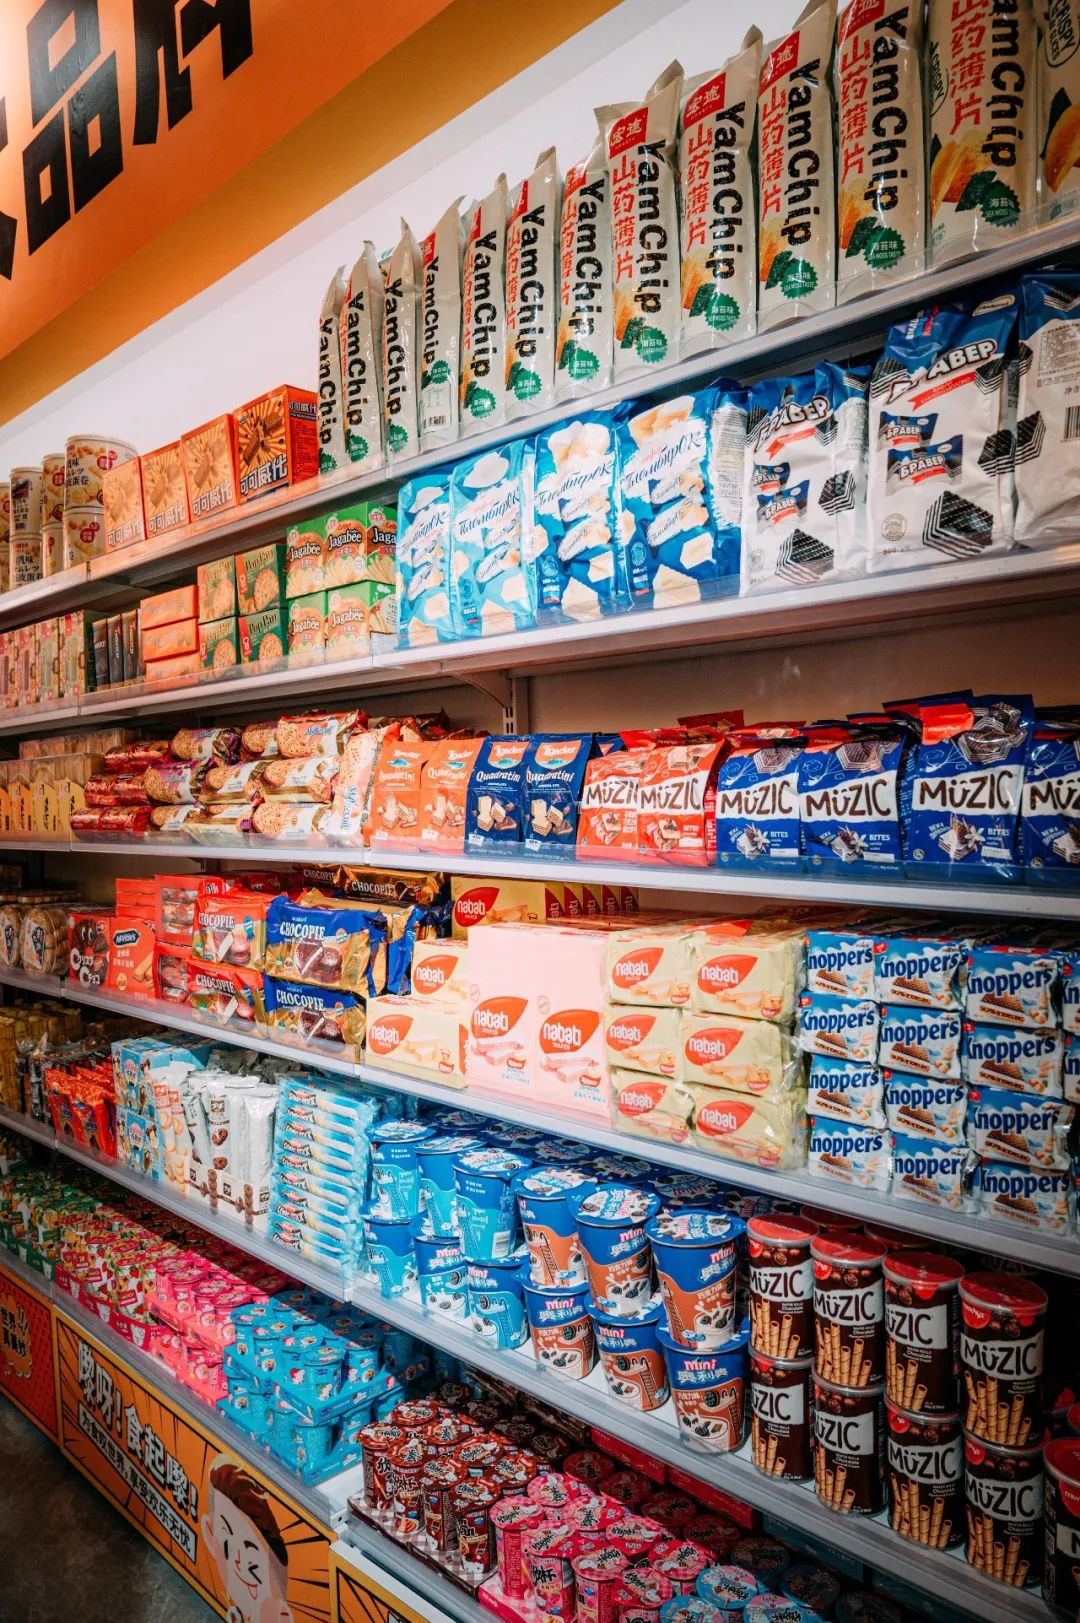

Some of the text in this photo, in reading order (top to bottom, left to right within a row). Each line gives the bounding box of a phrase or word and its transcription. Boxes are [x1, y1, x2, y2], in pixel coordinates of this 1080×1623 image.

[981, 0, 1025, 168] amChip
[841, 35, 870, 184] 山药薄片
[864, 6, 909, 212] YamChip
[761, 86, 786, 222] 山药薄片
[780, 58, 821, 246] YamChip
[687, 123, 713, 251] 山药薄片
[705, 101, 746, 280] YamChip
[612, 154, 636, 283] 山药薄片
[634, 138, 669, 314] YamChip
[568, 178, 605, 337] YamChip
[515, 204, 545, 358] YamChip
[422, 256, 439, 364] YamChip
[470, 230, 497, 378] YamChip
[239, 454, 288, 495] 可可威化
[899, 454, 945, 480] БРАВЕР
[373, 527, 397, 544] Jaga
[526, 770, 575, 783] Quadratini
[770, 830, 788, 838] BITES
[987, 828, 1010, 836] BITES
[351, 880, 394, 896] CHOCOPIE
[456, 899, 486, 917] nabati
[280, 921, 326, 941] CHOCOPIE
[415, 966, 445, 984] nabati
[615, 958, 650, 977] nabati
[700, 963, 740, 984] nabati
[195, 974, 236, 993] CHOCOPIE
[276, 989, 326, 1011] CHOCOPIE
[474, 1007, 510, 1031] nabati
[371, 1024, 399, 1045] nabati
[542, 1023, 582, 1047] nabati
[609, 1024, 641, 1043] nabati
[688, 1036, 726, 1056] nabati
[620, 1090, 653, 1109] nabati
[701, 1108, 737, 1130] nabati
[545, 1298, 574, 1310] mini
[684, 1359, 717, 1371] mini
